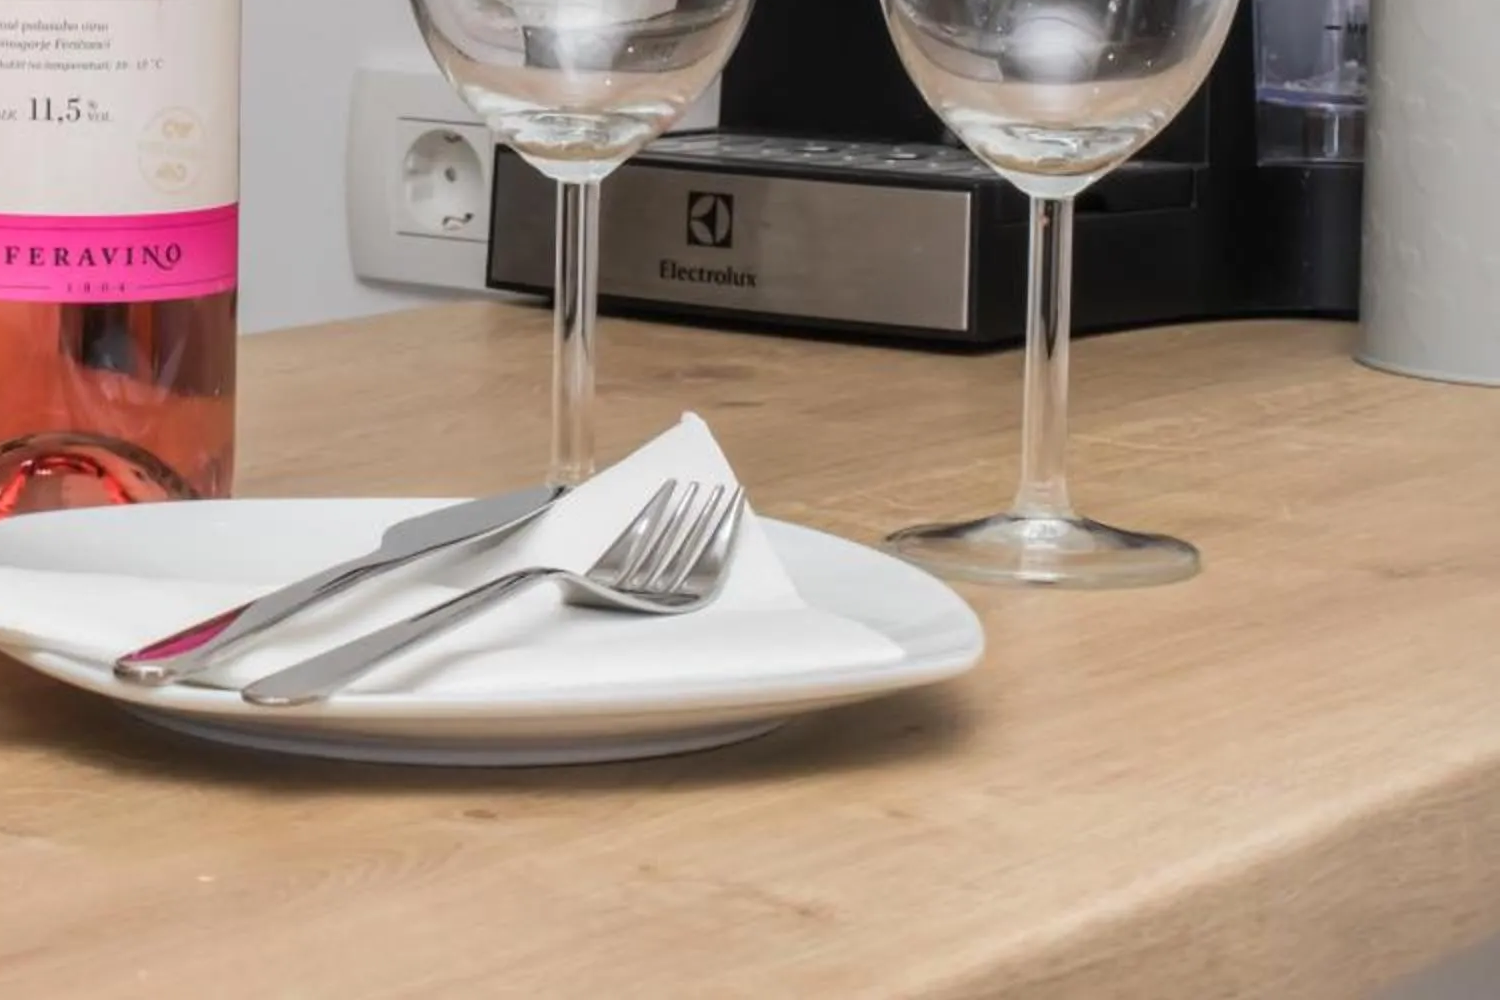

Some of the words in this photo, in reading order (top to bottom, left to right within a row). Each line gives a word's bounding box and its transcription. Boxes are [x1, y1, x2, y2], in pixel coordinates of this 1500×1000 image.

[28, 96, 82, 124] 11,5
[4, 243, 183, 270] FERAVINO
[659, 259, 757, 288] Electrolux
